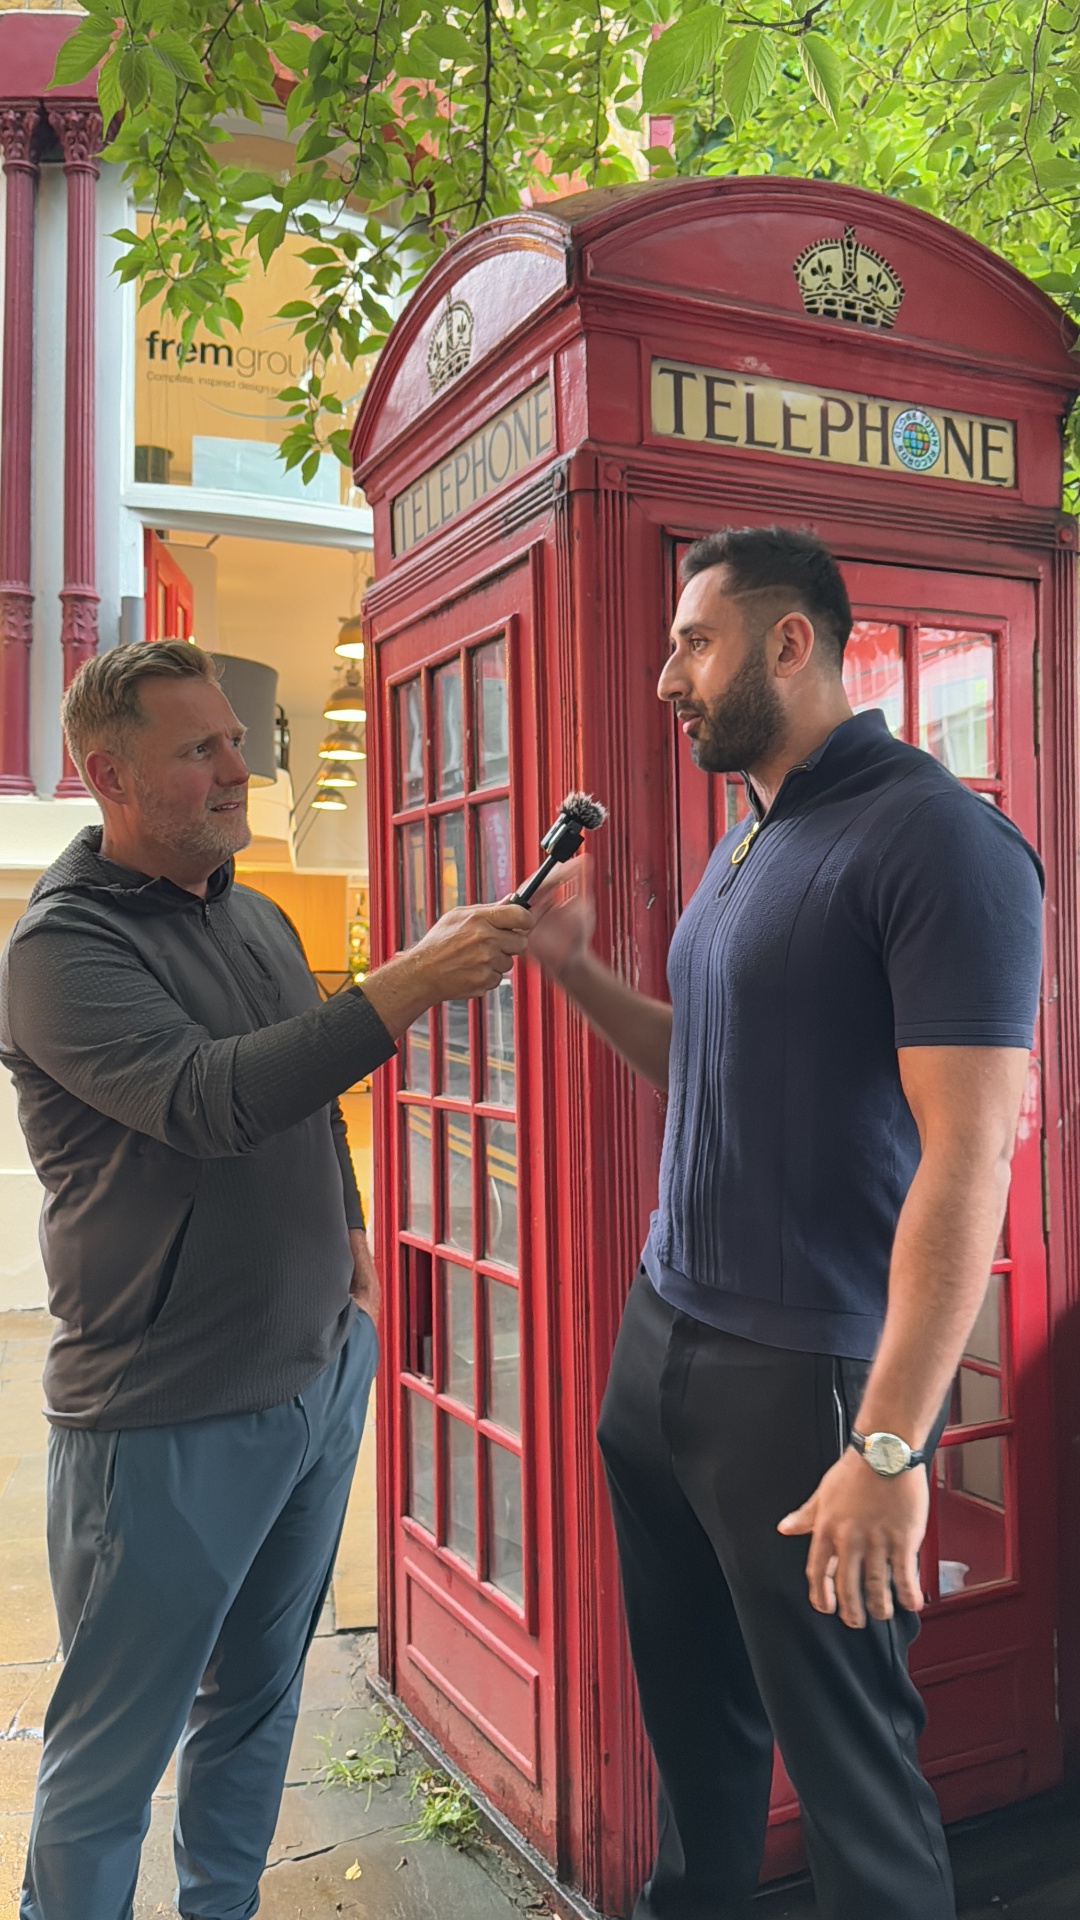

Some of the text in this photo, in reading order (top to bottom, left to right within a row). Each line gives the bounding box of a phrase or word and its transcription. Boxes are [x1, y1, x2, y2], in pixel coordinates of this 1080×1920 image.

[658, 368, 1008, 483] TELEPHNE
[898, 445, 937, 467] RECORDS
[920, 415, 938, 447] TOWN
[397, 384, 551, 551] TELEPHONE
